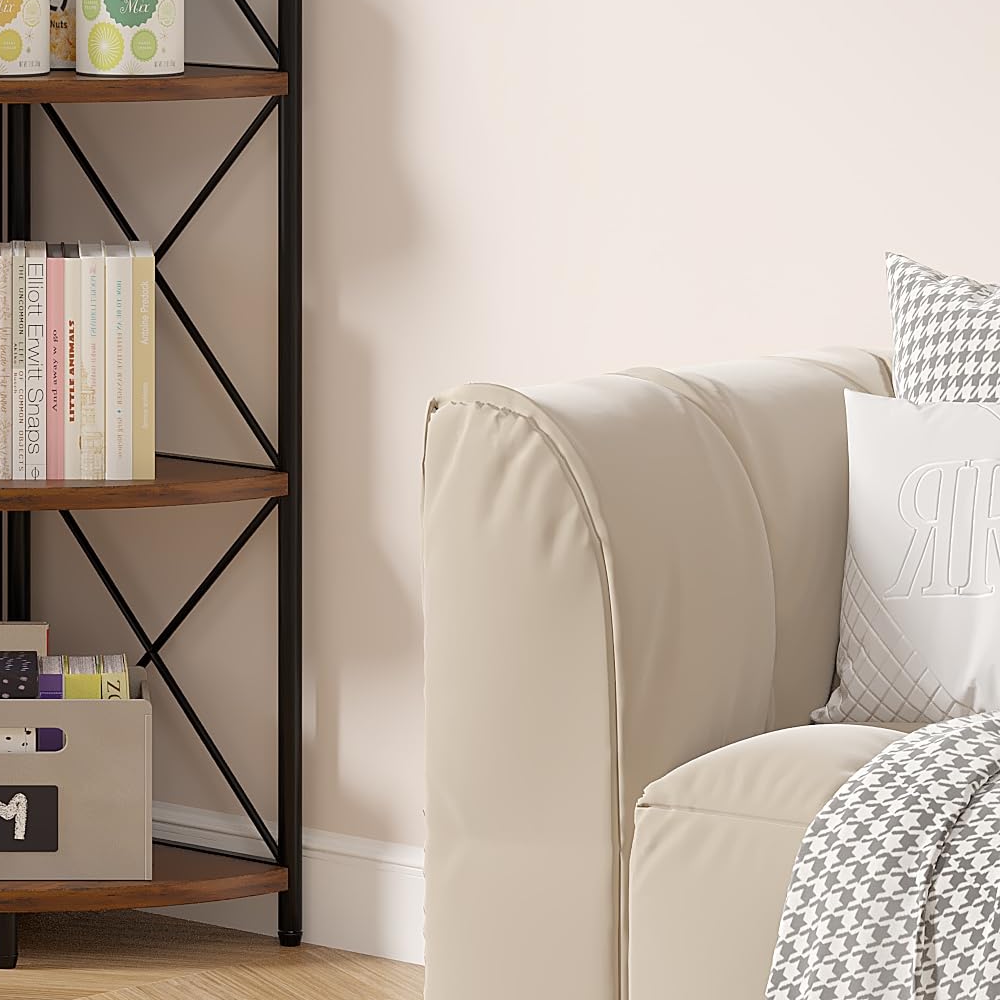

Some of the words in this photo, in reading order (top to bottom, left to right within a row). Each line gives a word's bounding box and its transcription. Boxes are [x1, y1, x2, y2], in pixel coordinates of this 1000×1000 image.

[50, 20, 68, 29] Nuts
[28, 263, 44, 316] Elliott
[28, 325, 44, 380] Erwitt
[53, 329, 59, 343] go
[18, 370, 24, 380] OF
[25, 388, 44, 454] Snaps
